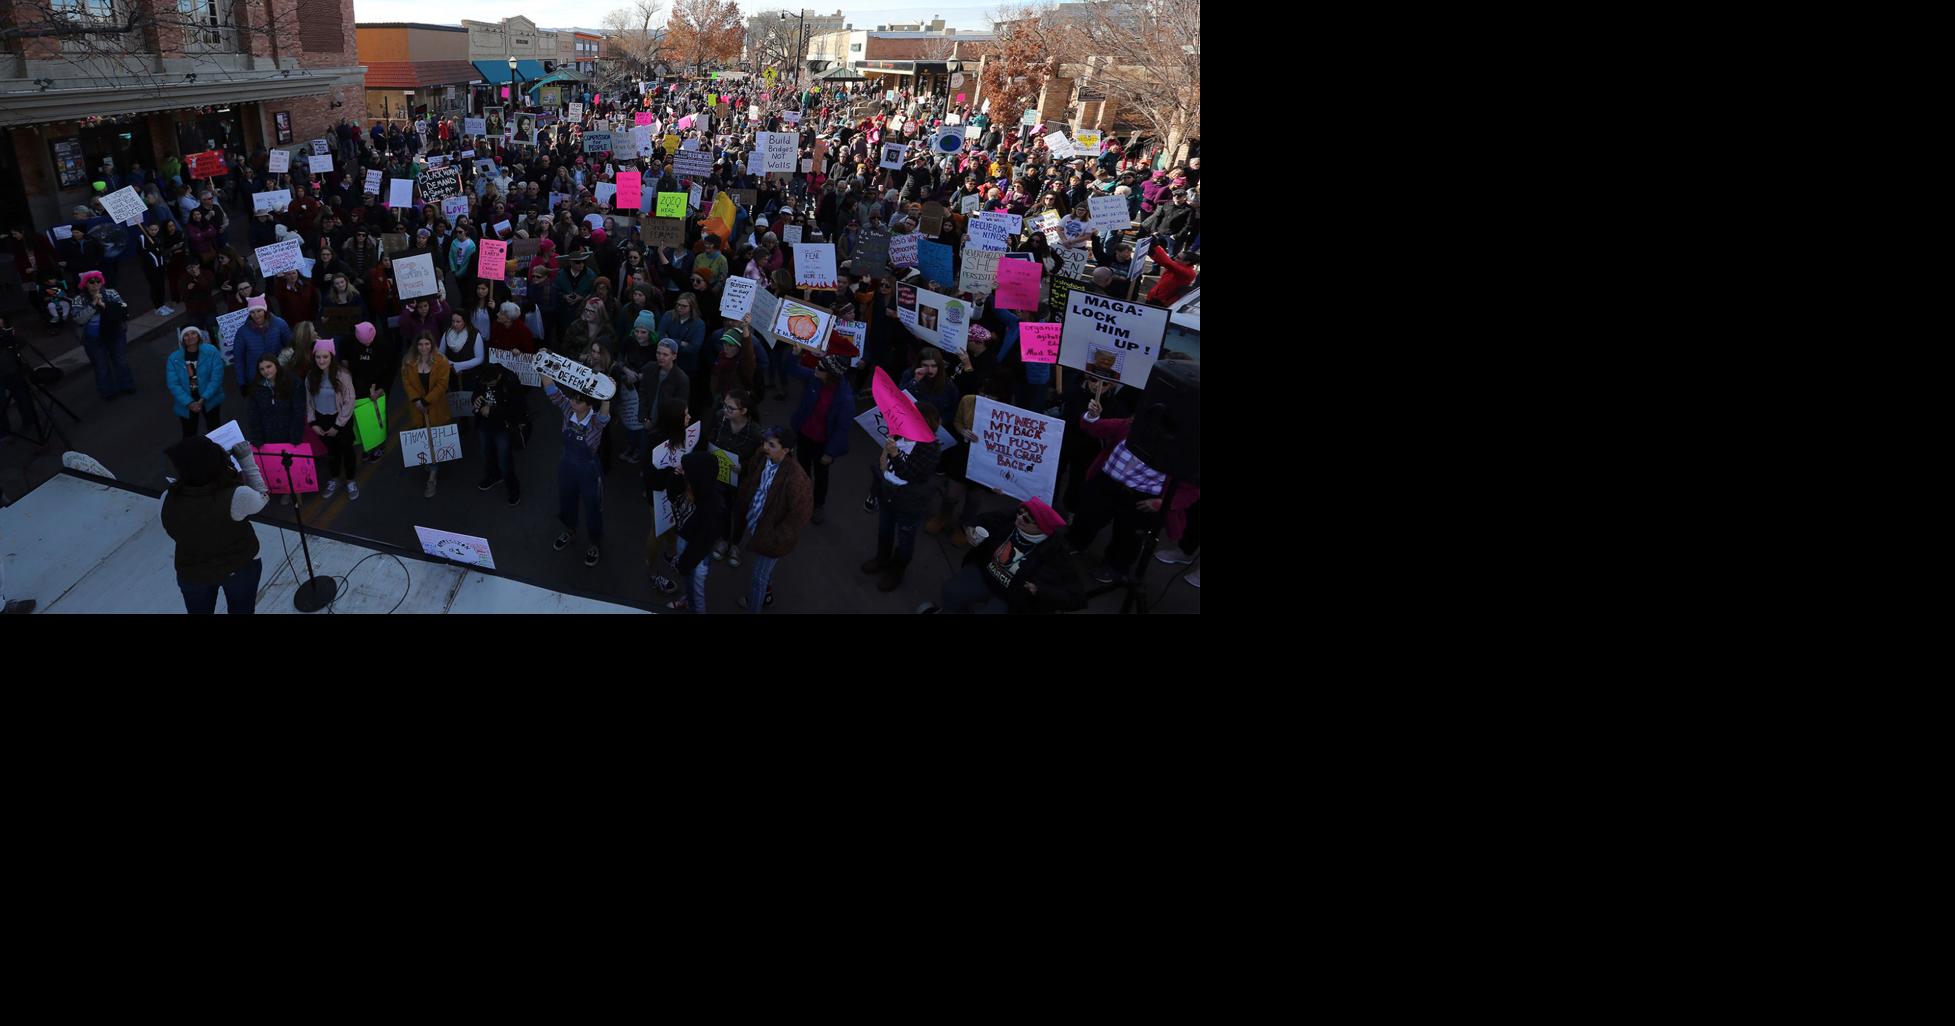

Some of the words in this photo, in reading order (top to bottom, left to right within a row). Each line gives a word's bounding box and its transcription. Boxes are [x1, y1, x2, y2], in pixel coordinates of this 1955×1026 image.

[768, 135, 791, 144] Build
[768, 145, 793, 153] Bridges
[427, 177, 457, 190] DEMAND
[423, 190, 430, 199] A
[115, 203, 144, 221] RESPECTED
[446, 205, 469, 215] LOVE
[970, 220, 1008, 234] RECUERDA
[1056, 248, 1085, 262] DEAD
[964, 257, 1001, 273] SHE
[1063, 261, 1080, 271] EN
[963, 271, 998, 281] PERSISTED
[1059, 269, 1080, 280] ONT
[1085, 296, 1143, 316] MAGA:
[1073, 305, 1116, 325] LOCK
[1025, 326, 1061, 334] organiz
[1096, 322, 1130, 339] HIM
[1037, 334, 1060, 342] agitat
[562, 359, 572, 371] LA
[577, 365, 589, 377] VIE
[558, 370, 568, 383] DE
[568, 376, 595, 395] FEME
[992, 409, 1014, 423] MY
[1015, 415, 1048, 432] NECK
[432, 426, 456, 438] THE
[990, 420, 1011, 434] MY
[1013, 426, 1042, 440] BACK
[402, 431, 427, 447] WALL
[983, 430, 1002, 442] MY
[1009, 437, 1047, 455] PUSSY
[985, 440, 1012, 457] WILL
[1013, 449, 1042, 463] GRAB
[997, 454, 1025, 471] BACK
